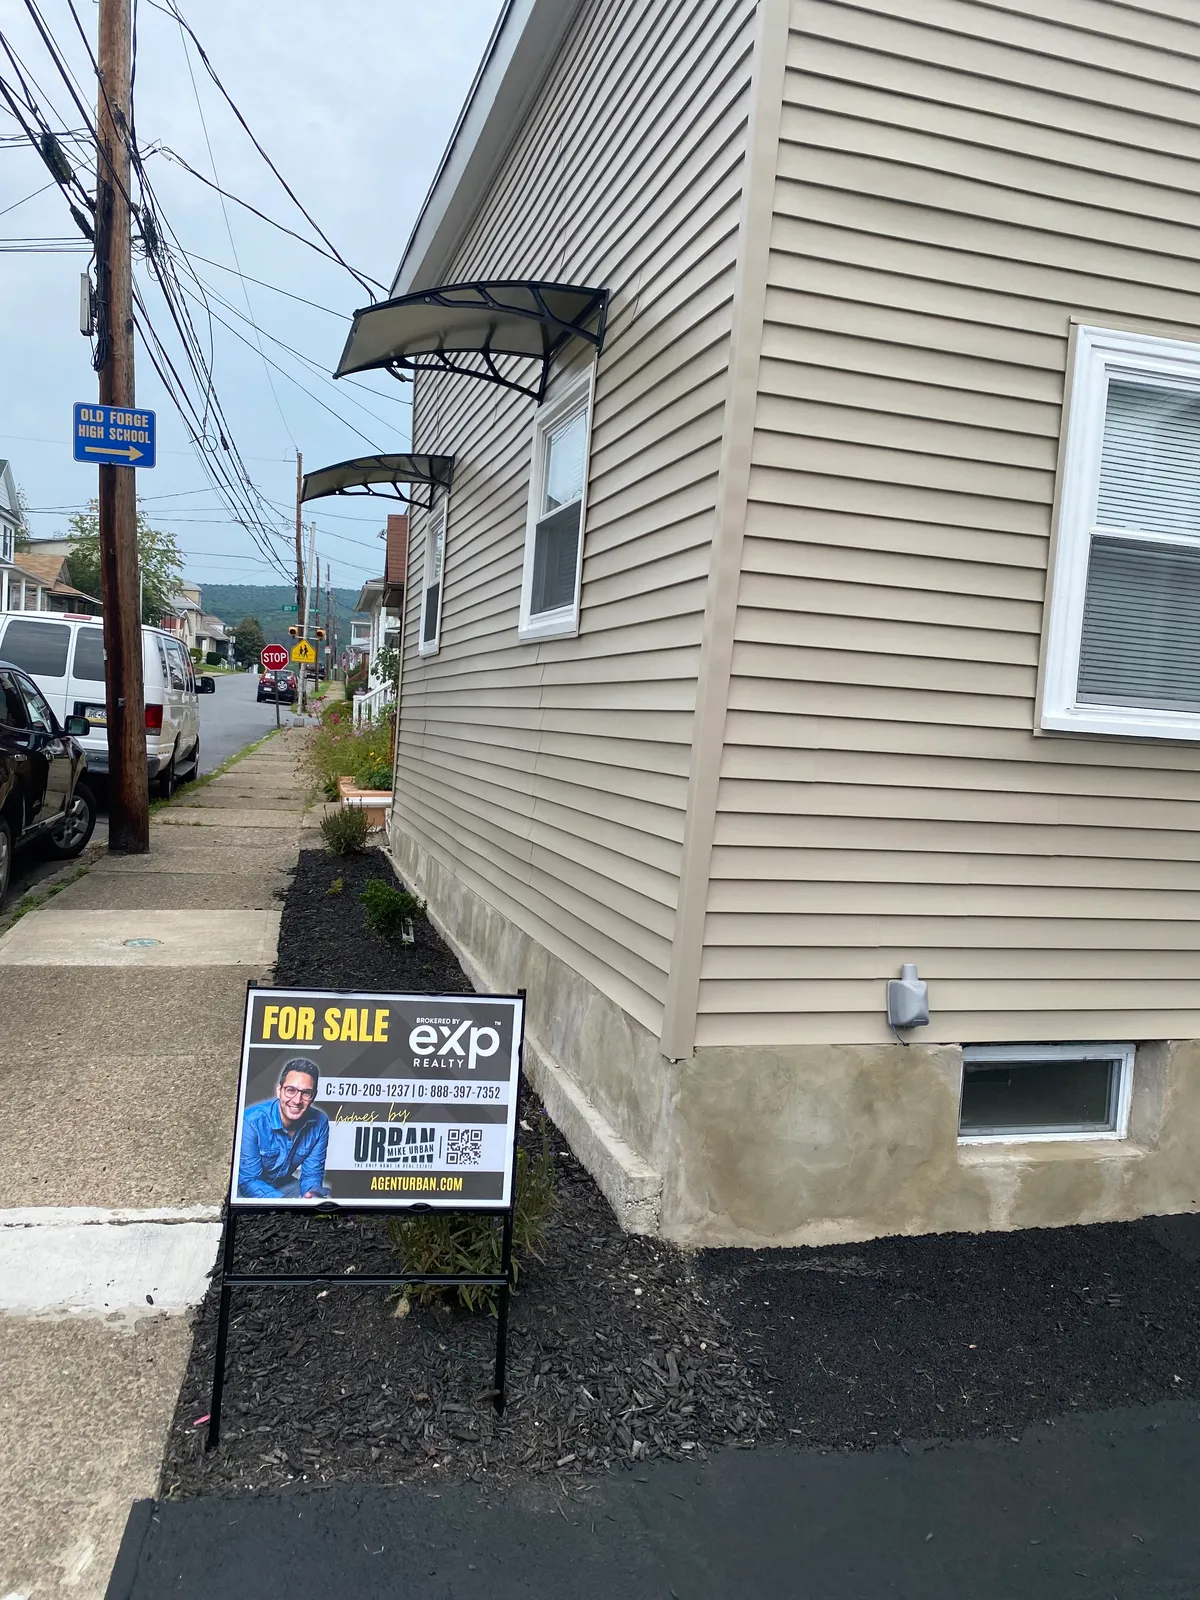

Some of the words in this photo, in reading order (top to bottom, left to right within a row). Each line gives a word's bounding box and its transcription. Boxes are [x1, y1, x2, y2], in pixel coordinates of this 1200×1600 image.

[81, 408, 104, 423] OLD
[110, 411, 149, 428] FORGE
[78, 424, 104, 439] HIGH
[109, 427, 151, 444] SCHOOL
[263, 652, 287, 663] STOP
[262, 1005, 316, 1040] FOR
[323, 1007, 390, 1042] SALE
[416, 1017, 451, 1025] BROKERED
[413, 1058, 464, 1068] REALTY
[325, 1082, 336, 1096] C:
[338, 1083, 410, 1097] 570-209-1237
[430, 1085, 501, 1099] 888-397-7352
[334, 1104, 380, 1126] homes
[387, 1101, 411, 1126] by
[353, 1126, 436, 1163] URBAN
[387, 1147, 406, 1157] MIKE
[408, 1144, 434, 1155] URBAN
[370, 1176, 463, 1191] AGENTURBAN.COM
